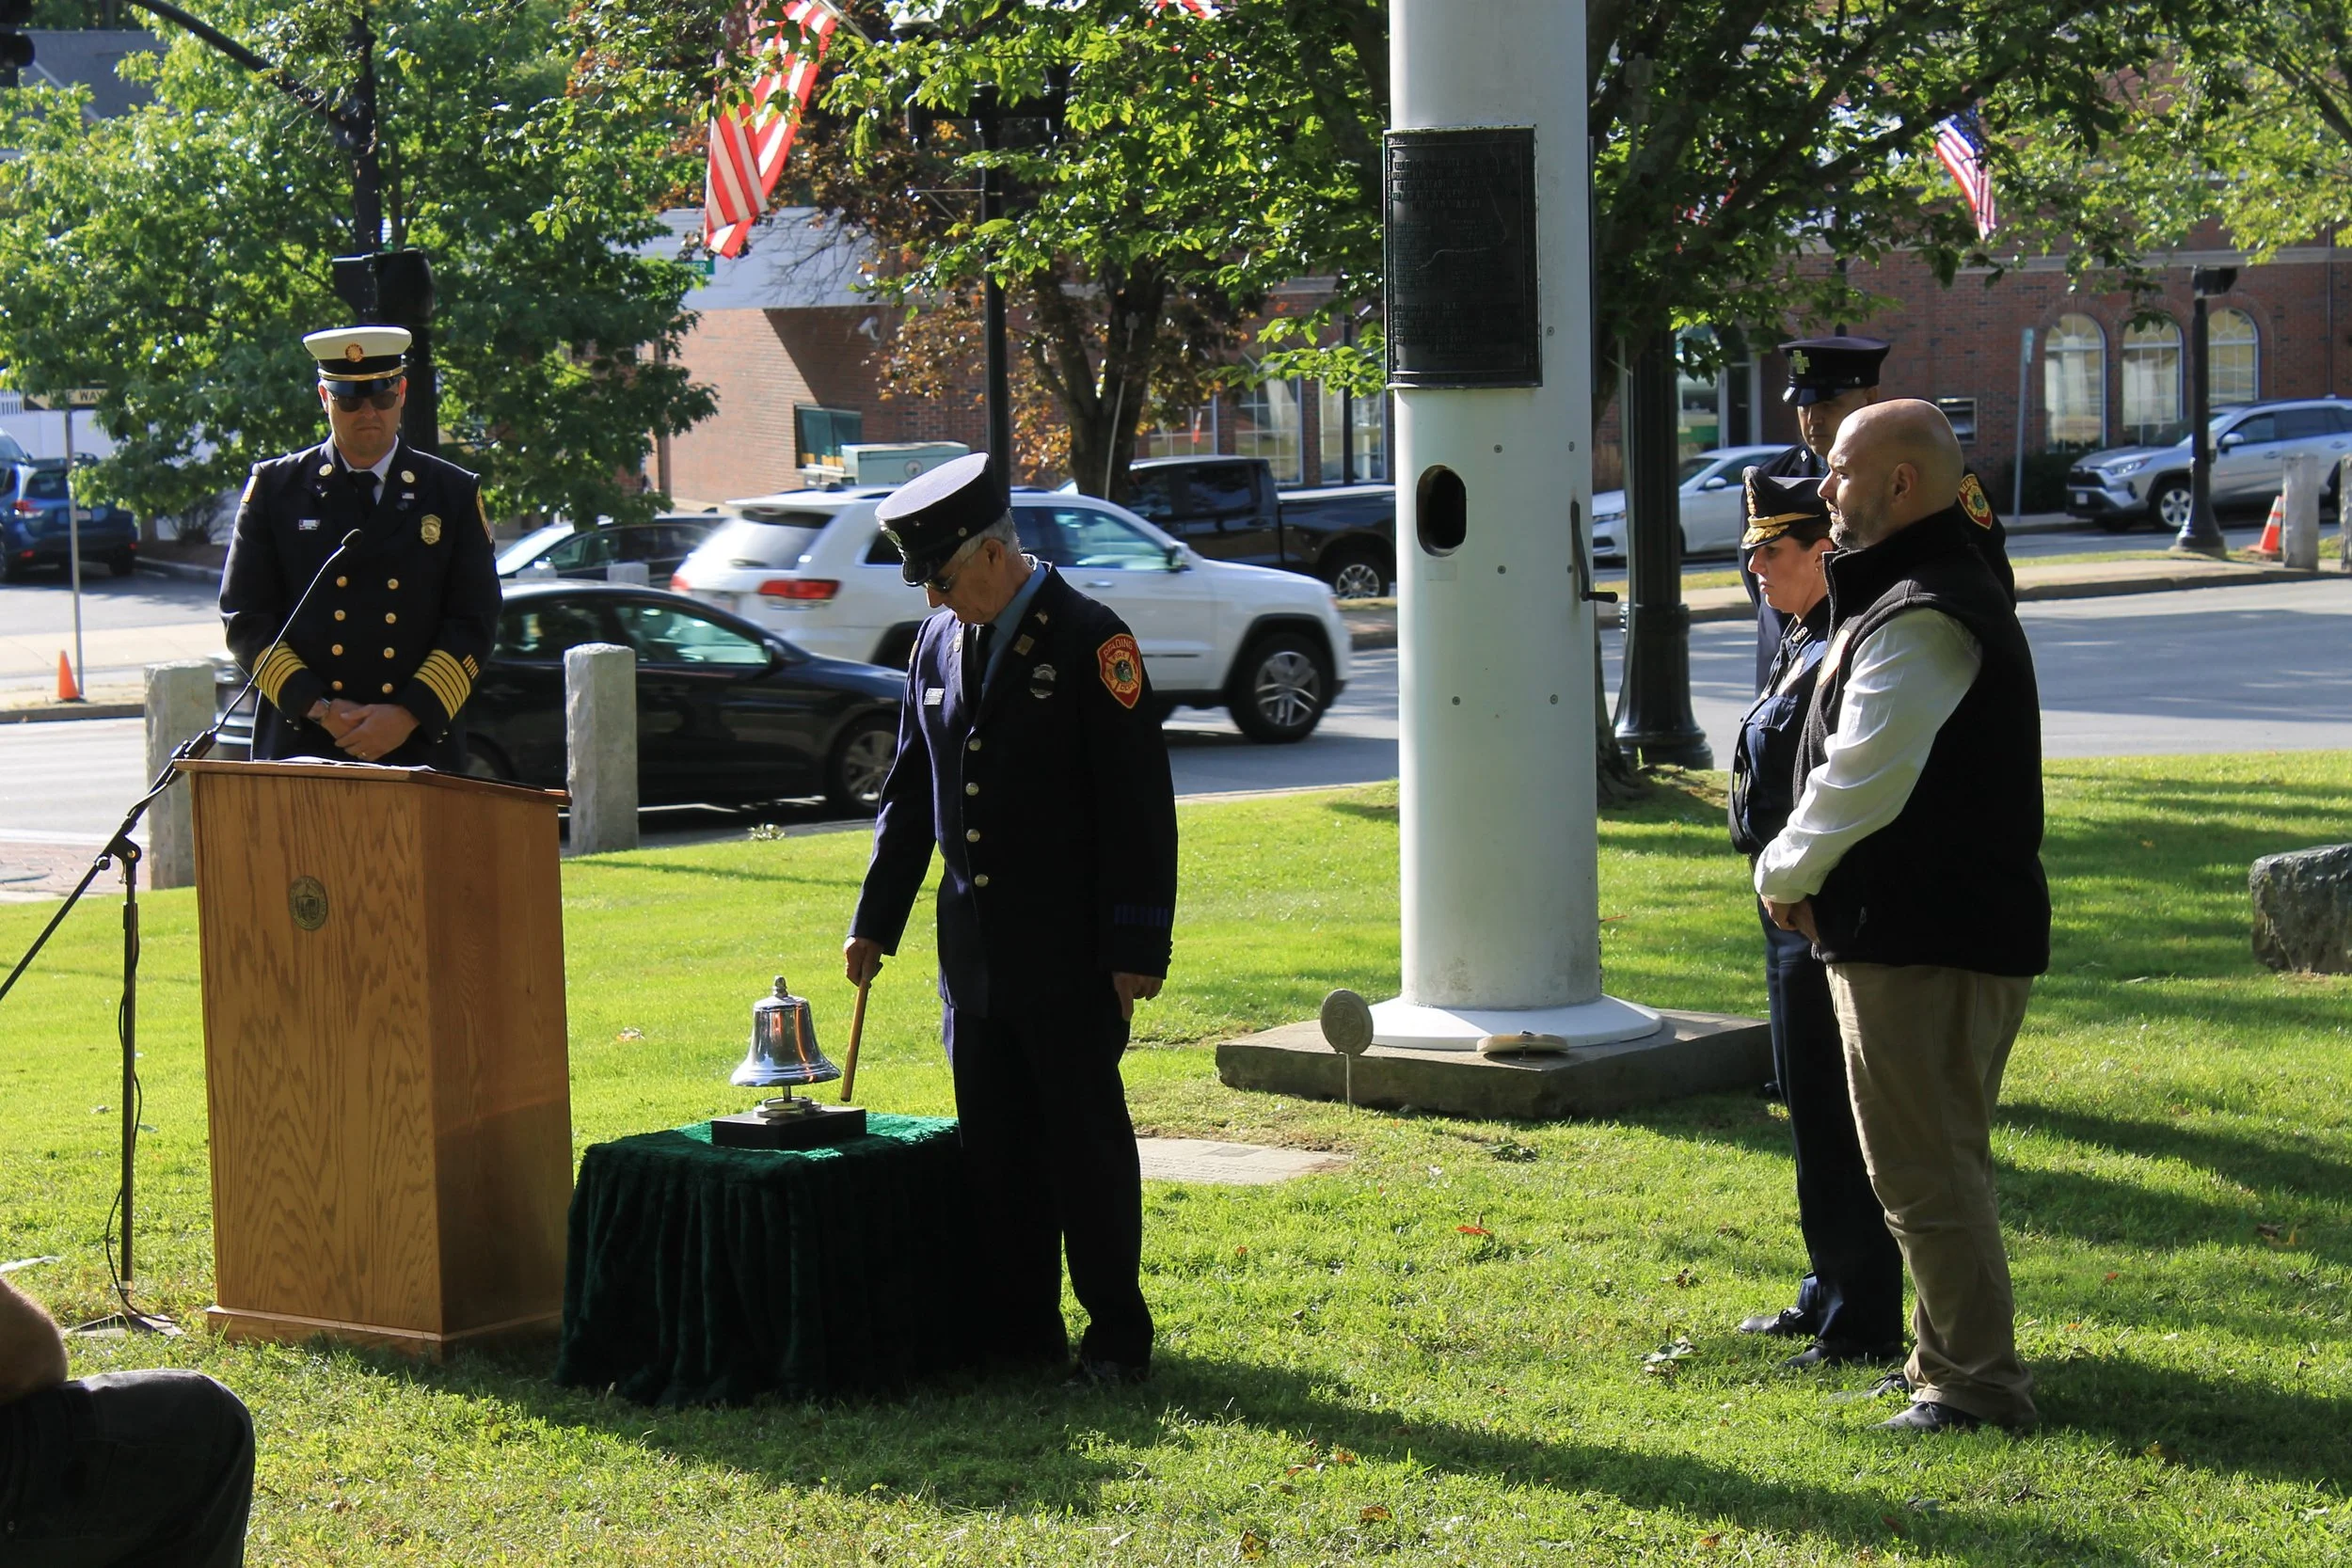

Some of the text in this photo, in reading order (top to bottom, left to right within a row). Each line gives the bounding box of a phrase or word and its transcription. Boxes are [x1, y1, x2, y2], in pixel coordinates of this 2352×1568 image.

[79, 390, 104, 402] WAY
[1103, 638, 1134, 658] READING
[1113, 652, 1127, 660] FIRE
[1120, 682, 1136, 691] DEPT
